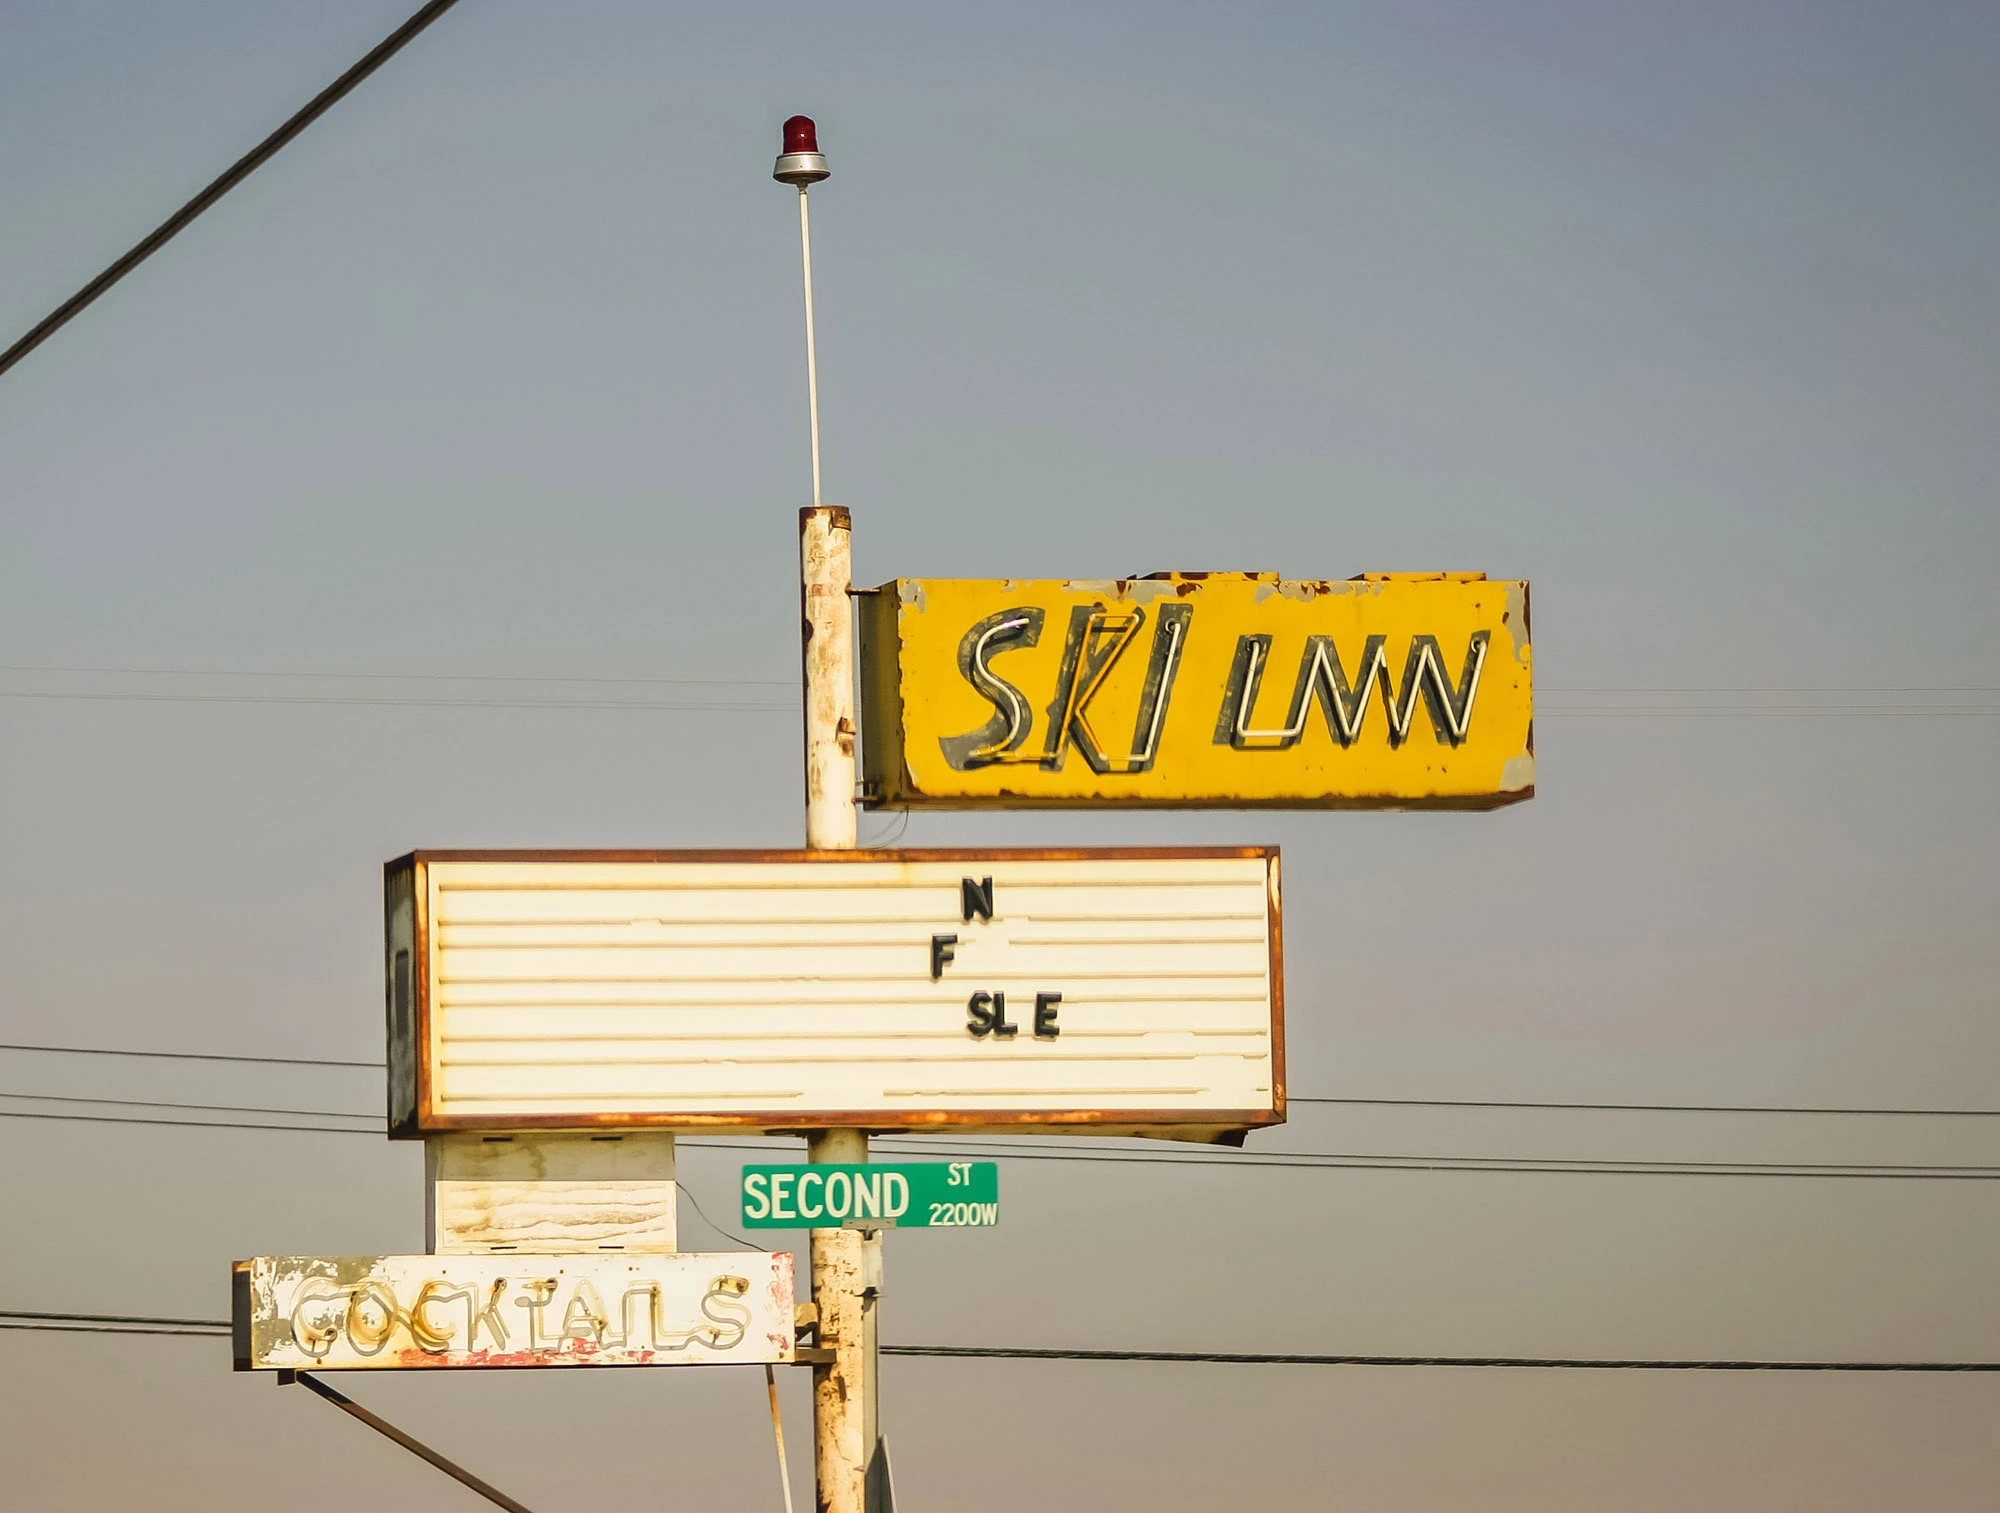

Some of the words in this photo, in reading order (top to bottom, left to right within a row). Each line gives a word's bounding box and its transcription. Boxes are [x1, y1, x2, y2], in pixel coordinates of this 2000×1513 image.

[938, 603, 1194, 774] SKI
[962, 876, 993, 921] N
[931, 933, 958, 979] F
[744, 1172, 909, 1219] SECOND
[947, 1163, 973, 1186] ST
[928, 1202, 998, 1226] 2200W
[291, 1275, 752, 1357] COCKTAILS
